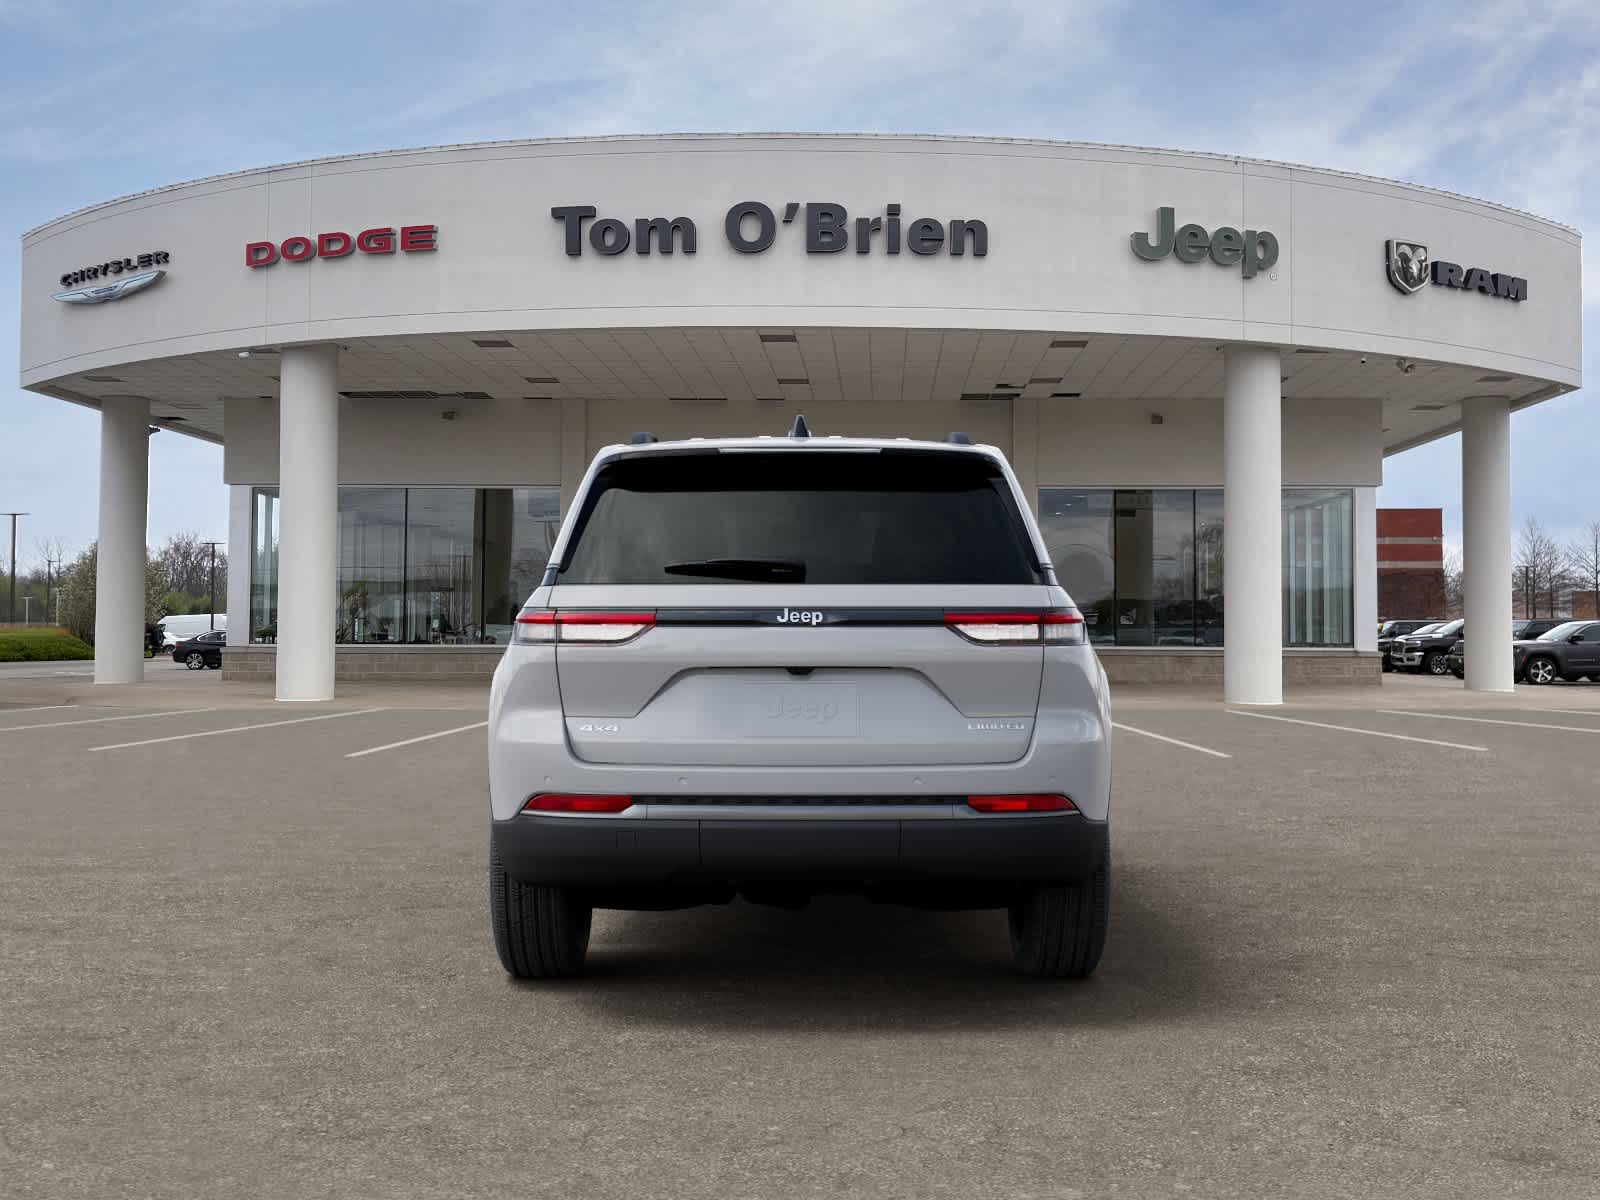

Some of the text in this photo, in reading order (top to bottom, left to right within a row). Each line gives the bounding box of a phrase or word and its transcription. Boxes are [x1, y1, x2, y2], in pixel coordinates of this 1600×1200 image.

[246, 225, 437, 268] DODGE
[551, 201, 988, 256] Tom O'Brien
[1130, 207, 1279, 279] Jeep
[61, 251, 169, 286] CHRYSLER
[1431, 261, 1527, 301] RAM
[776, 607, 823, 626] Jeep
[767, 696, 839, 728] Jeep
